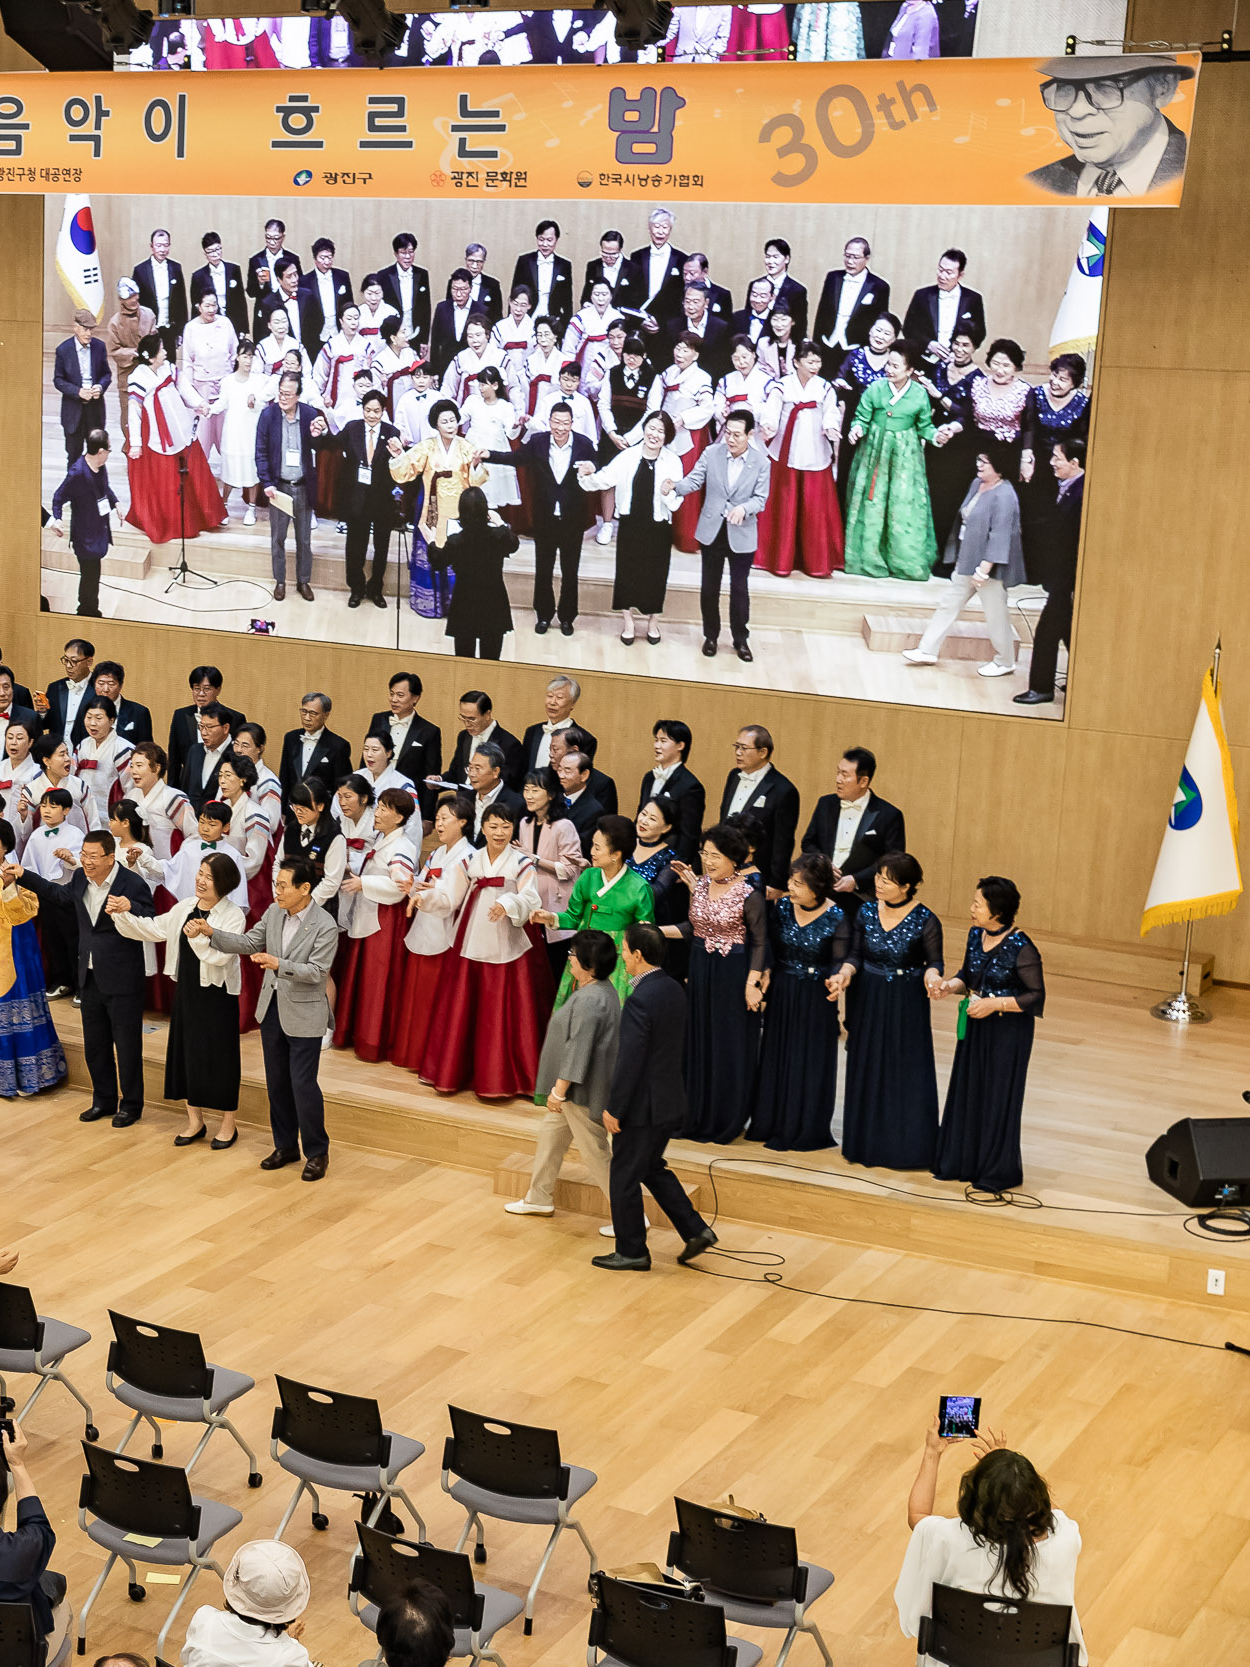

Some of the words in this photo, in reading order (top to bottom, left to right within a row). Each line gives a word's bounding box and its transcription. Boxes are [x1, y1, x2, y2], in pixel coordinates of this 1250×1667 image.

[608, 86, 686, 165] 밤
[758, 79, 938, 188] 30th
[40, 168, 82, 183] 대공연장
[321, 172, 374, 185] 광진구
[450, 171, 479, 188] 광진
[485, 171, 528, 188] 문화원
[598, 173, 704, 188] 한국시낭송가협회
